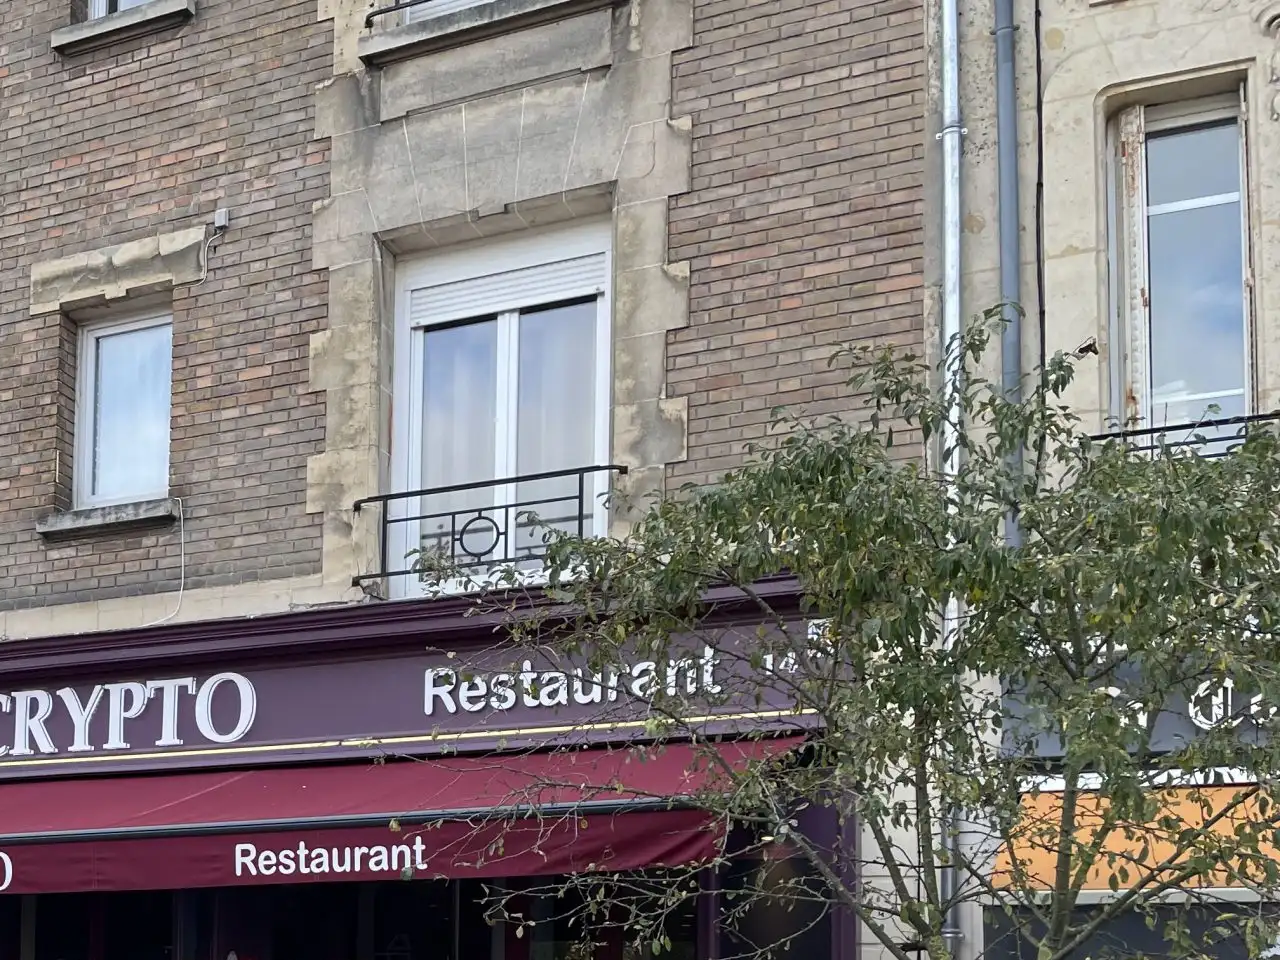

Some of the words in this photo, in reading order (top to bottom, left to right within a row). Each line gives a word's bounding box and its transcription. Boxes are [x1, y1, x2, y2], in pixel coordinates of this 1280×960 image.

[423, 646, 722, 716] Restaurant
[762, 652, 799, 675] 14
[235, 836, 428, 877] Restaurant
